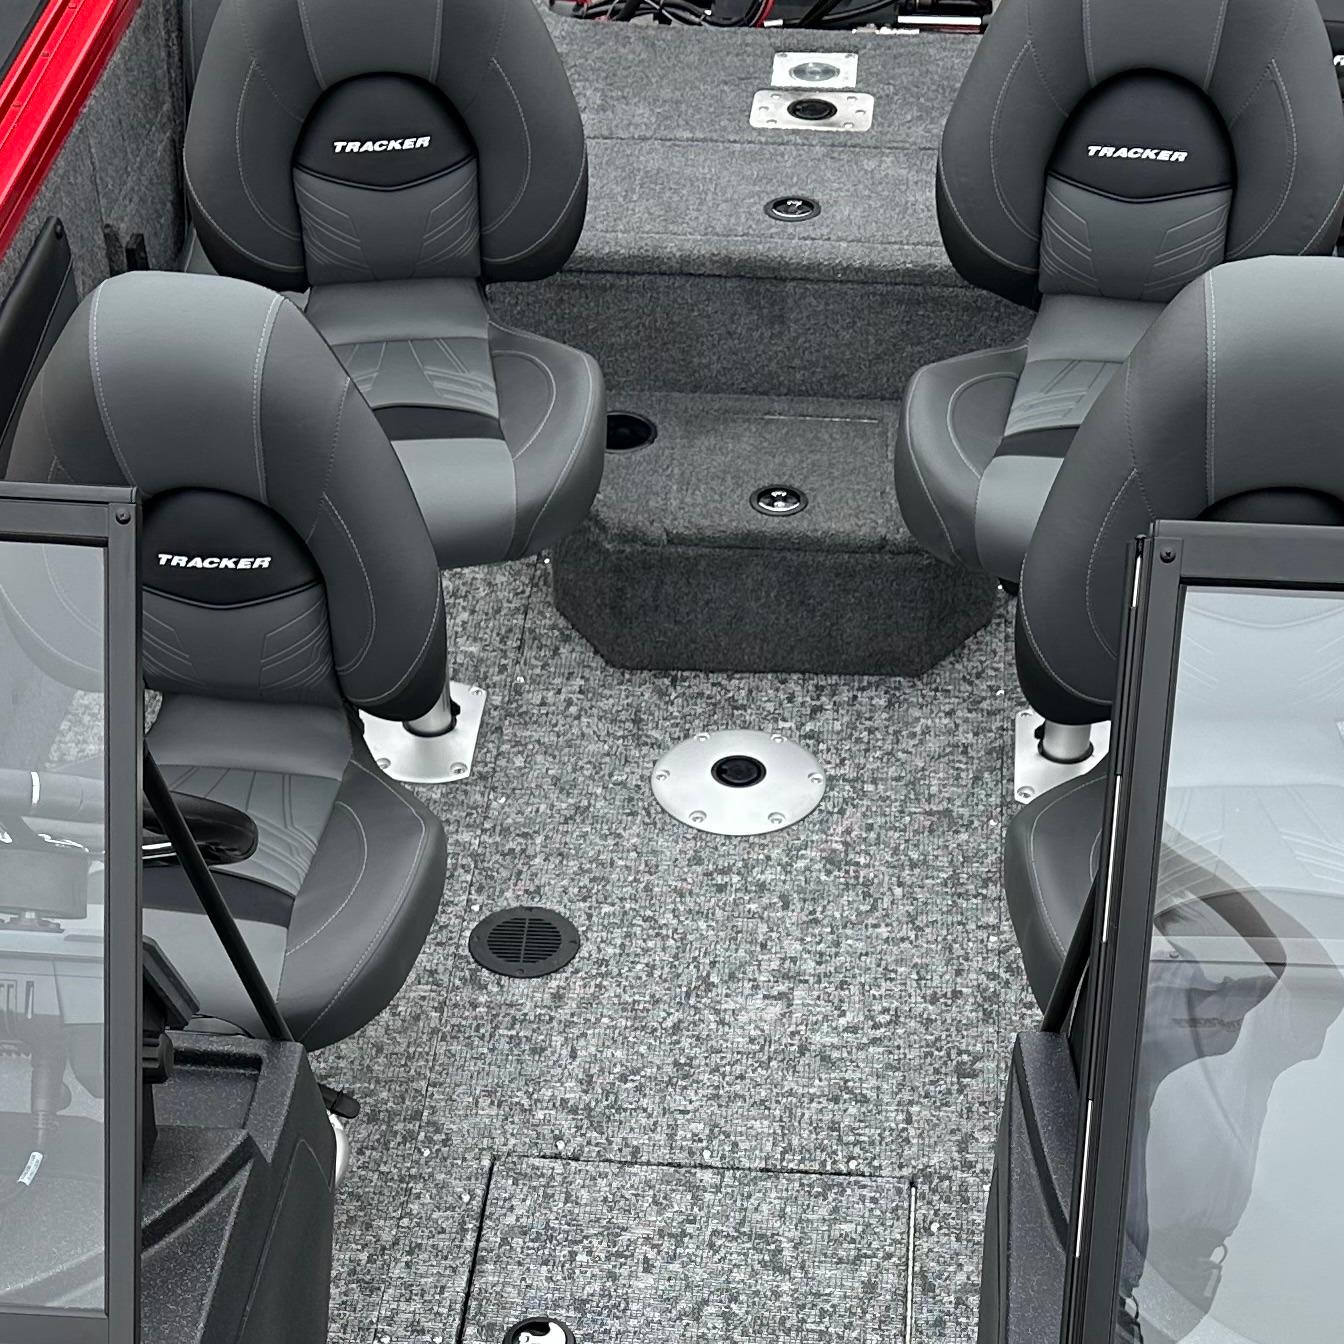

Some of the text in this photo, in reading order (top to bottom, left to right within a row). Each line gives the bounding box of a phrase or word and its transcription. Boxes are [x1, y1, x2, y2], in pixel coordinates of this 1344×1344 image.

[333, 136, 431, 153] TRACKER
[1087, 145, 1188, 162] TRACKER
[158, 553, 272, 570] TRACKER
